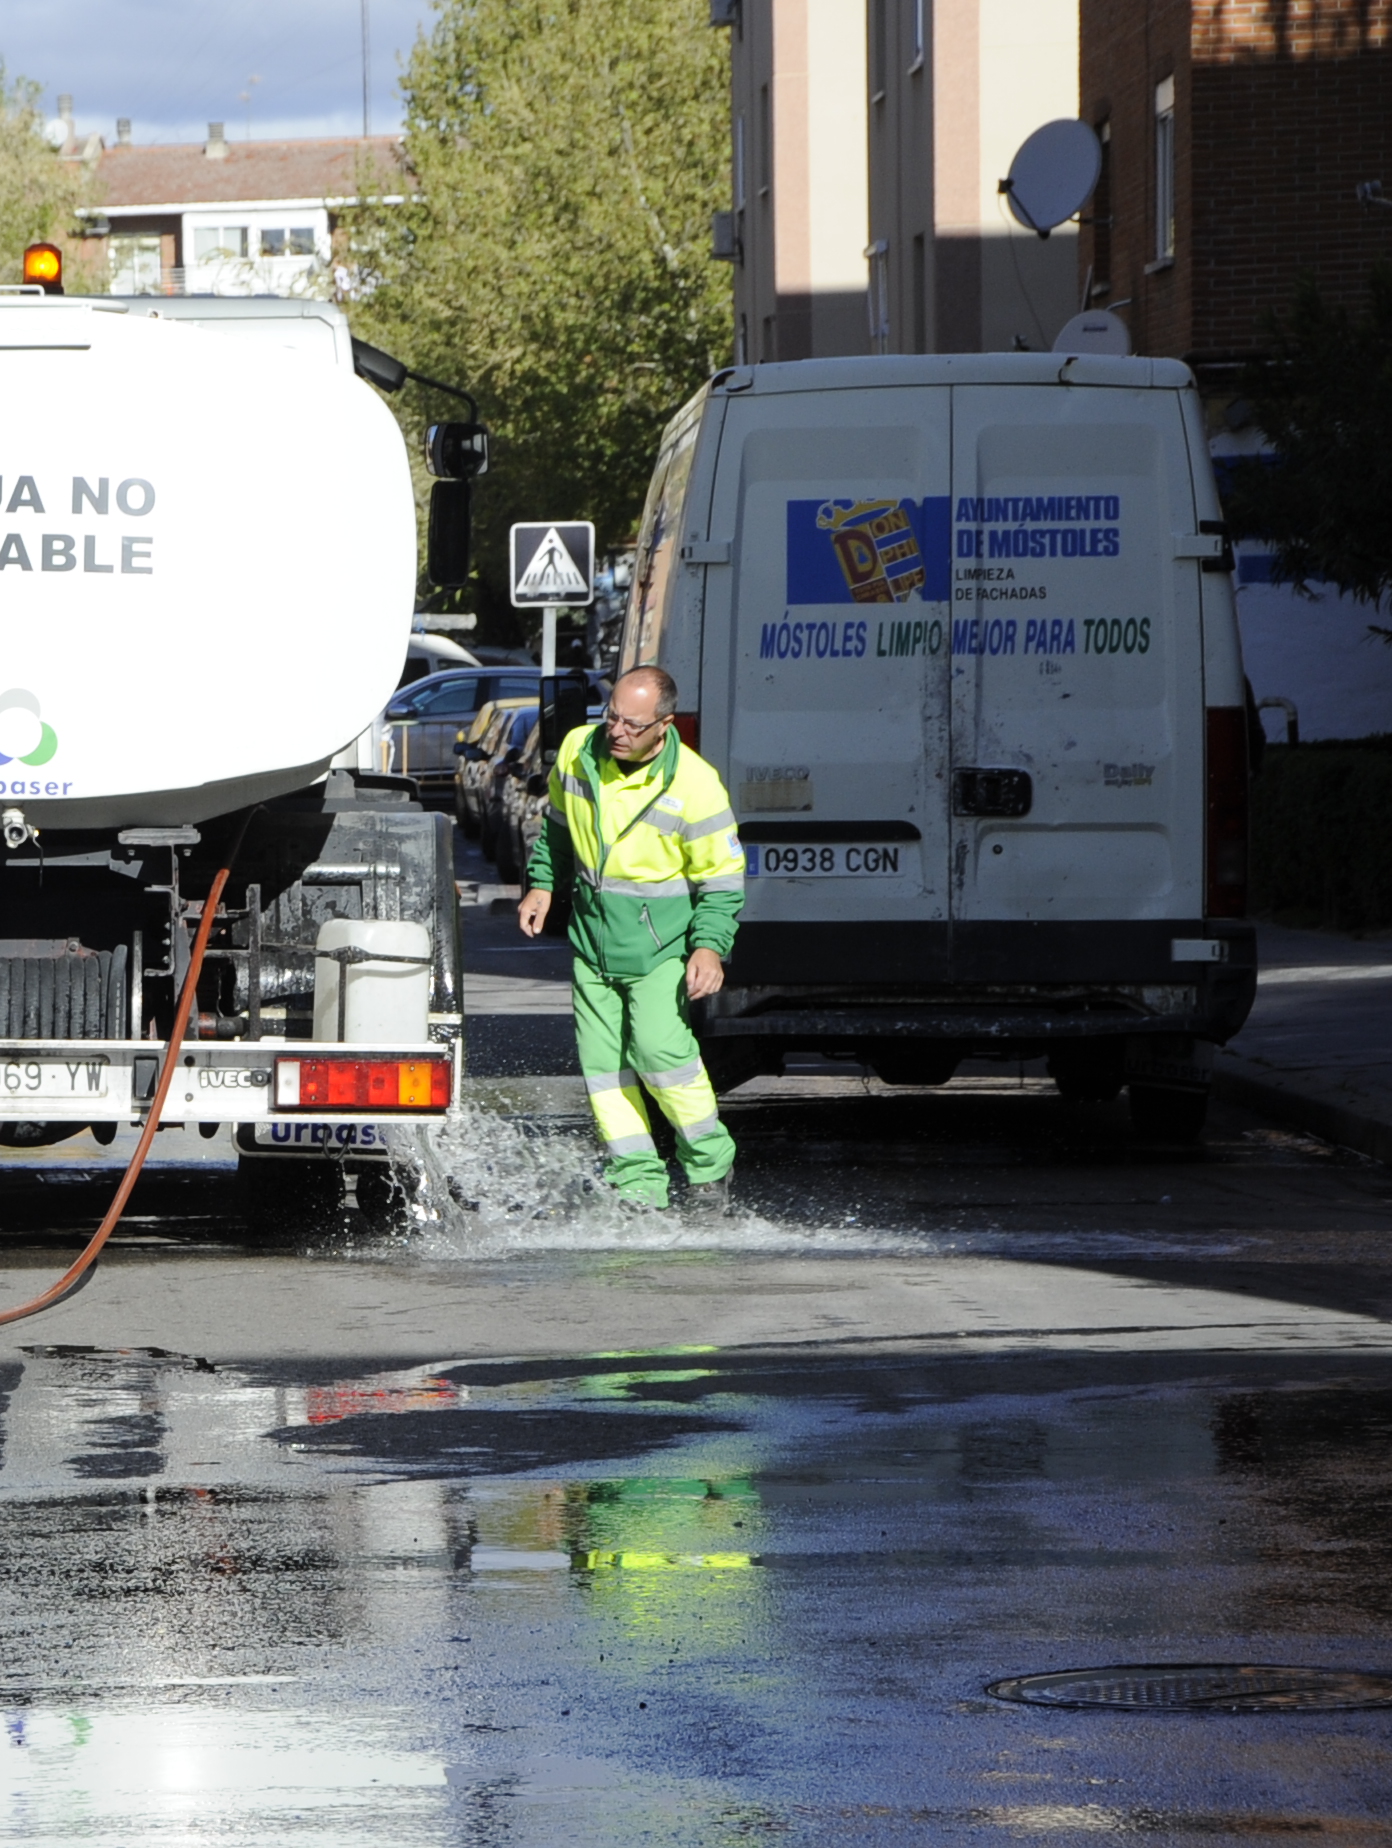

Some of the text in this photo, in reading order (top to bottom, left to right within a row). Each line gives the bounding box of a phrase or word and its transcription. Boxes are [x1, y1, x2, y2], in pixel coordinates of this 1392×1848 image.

[71, 476, 156, 516] NO
[956, 495, 1120, 523] AYUNTAMIENTO
[956, 523, 1120, 559] DE MÓSTOLES
[955, 567, 1015, 581] LIMPIEZA
[955, 586, 1047, 601] DE FACHADAS
[760, 610, 1151, 659] MÓSTOLES LIMPIO MEJOR PARA TODOS
[746, 766, 810, 782] IVECO
[765, 848, 835, 872] 0938
[845, 848, 898, 872] CGN
